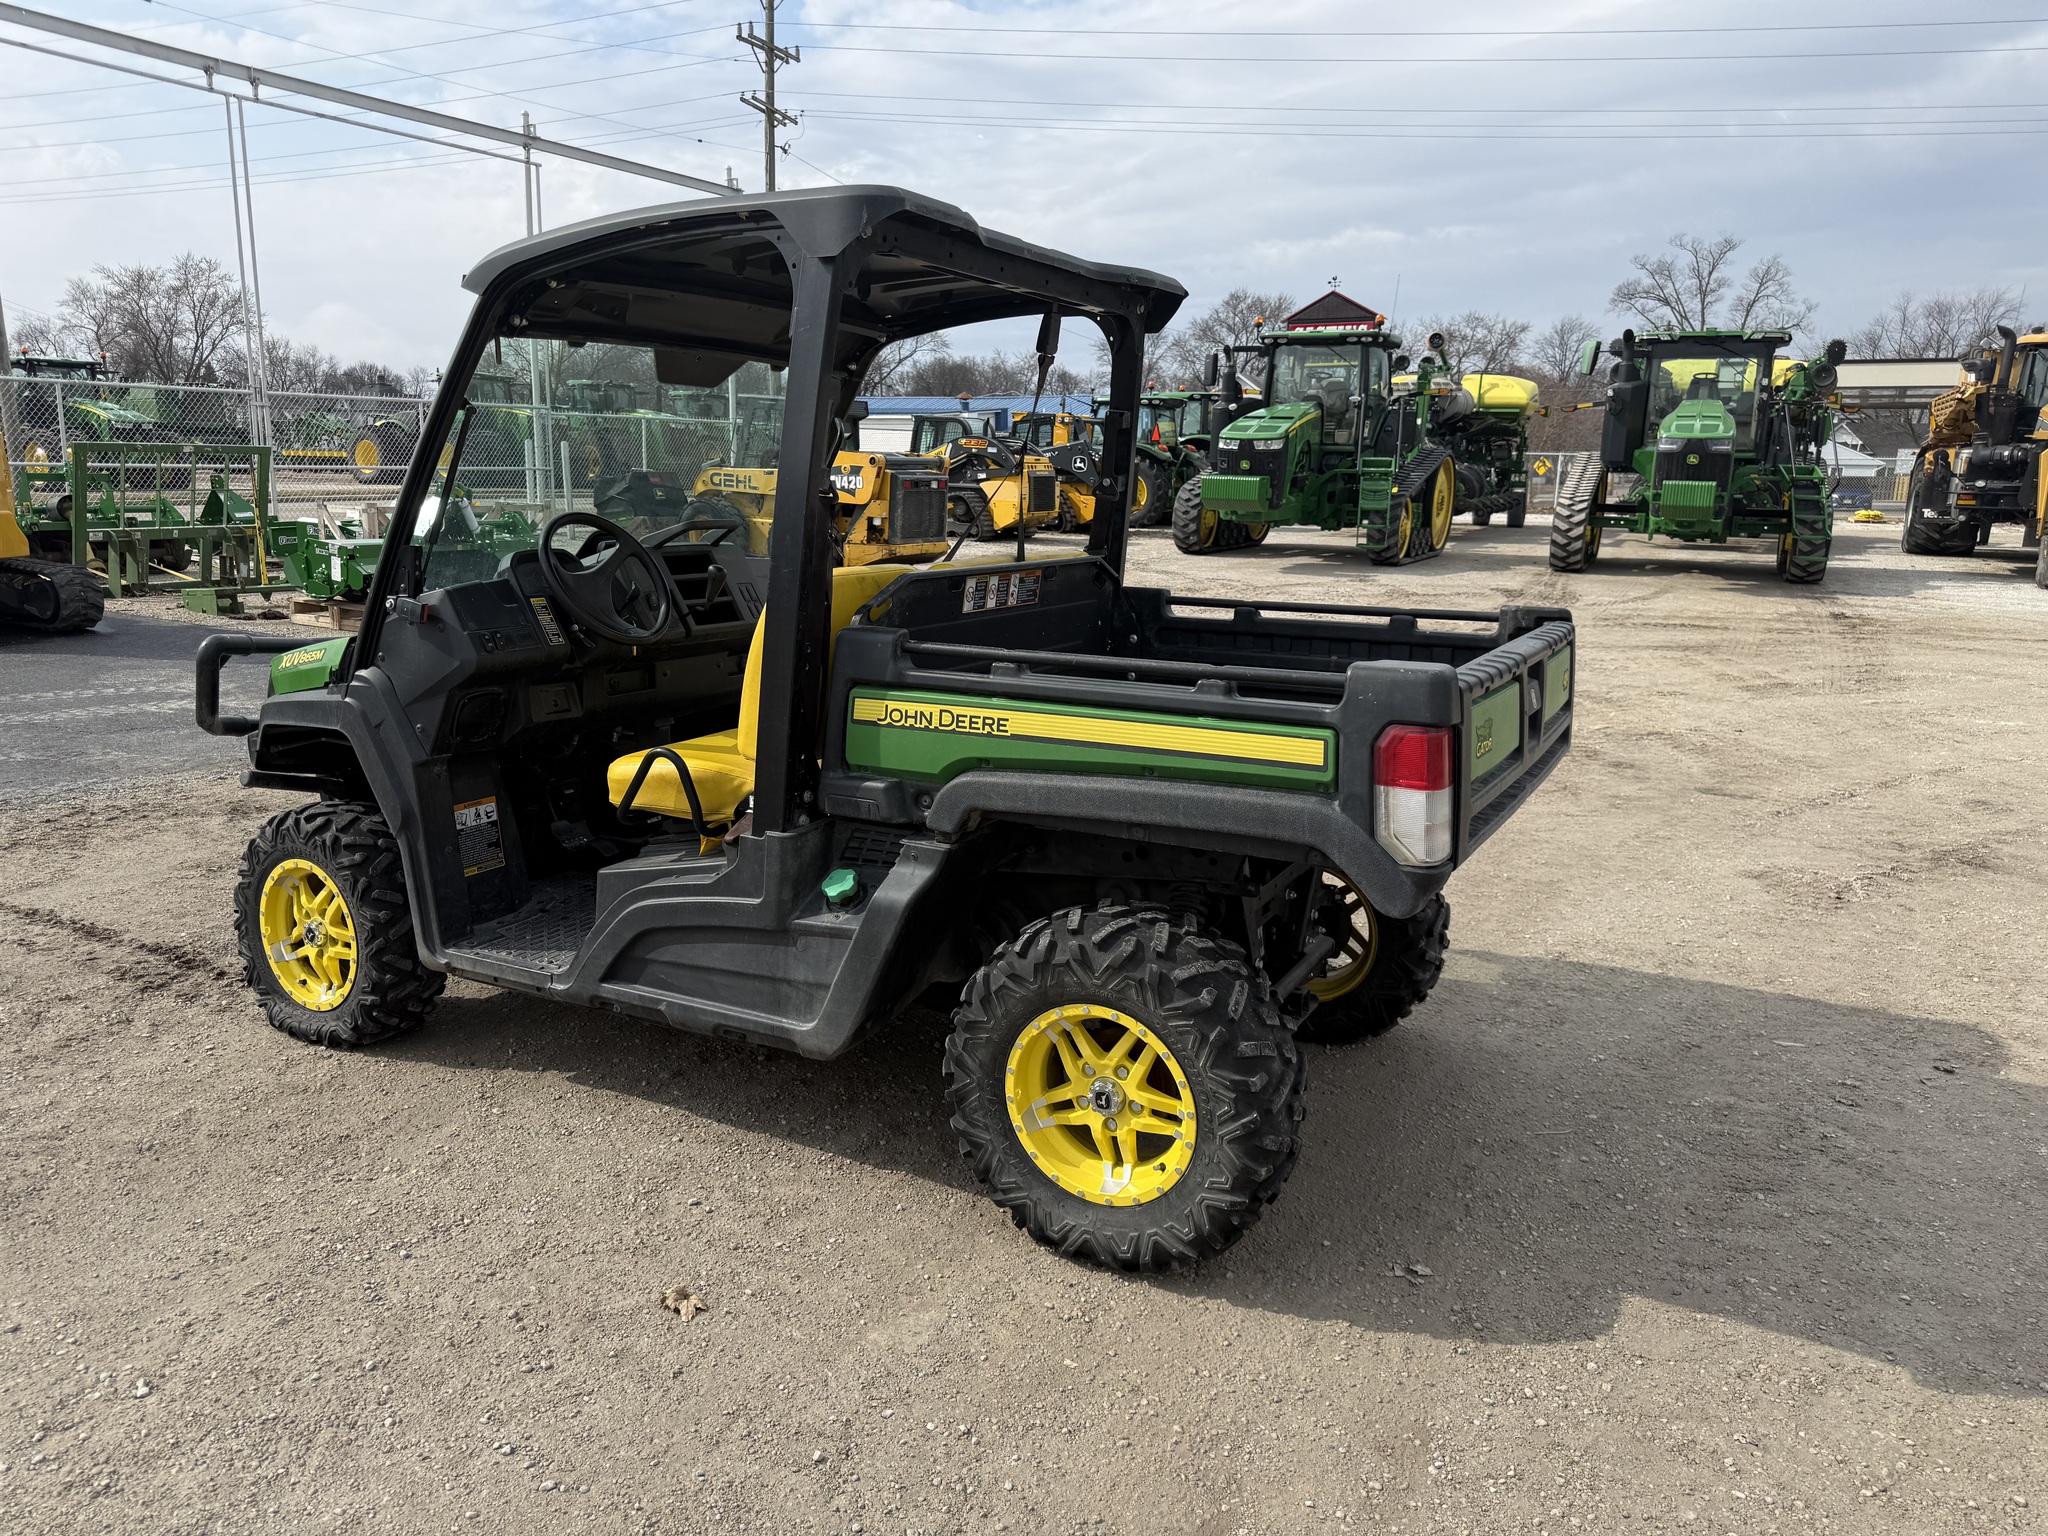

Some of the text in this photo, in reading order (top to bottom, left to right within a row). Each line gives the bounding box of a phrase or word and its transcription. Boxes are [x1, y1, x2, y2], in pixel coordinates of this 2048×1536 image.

[709, 472, 760, 491] GEHL
[876, 703, 1010, 734] JOHN DEERE
[1476, 737, 1493, 758] GATOR
